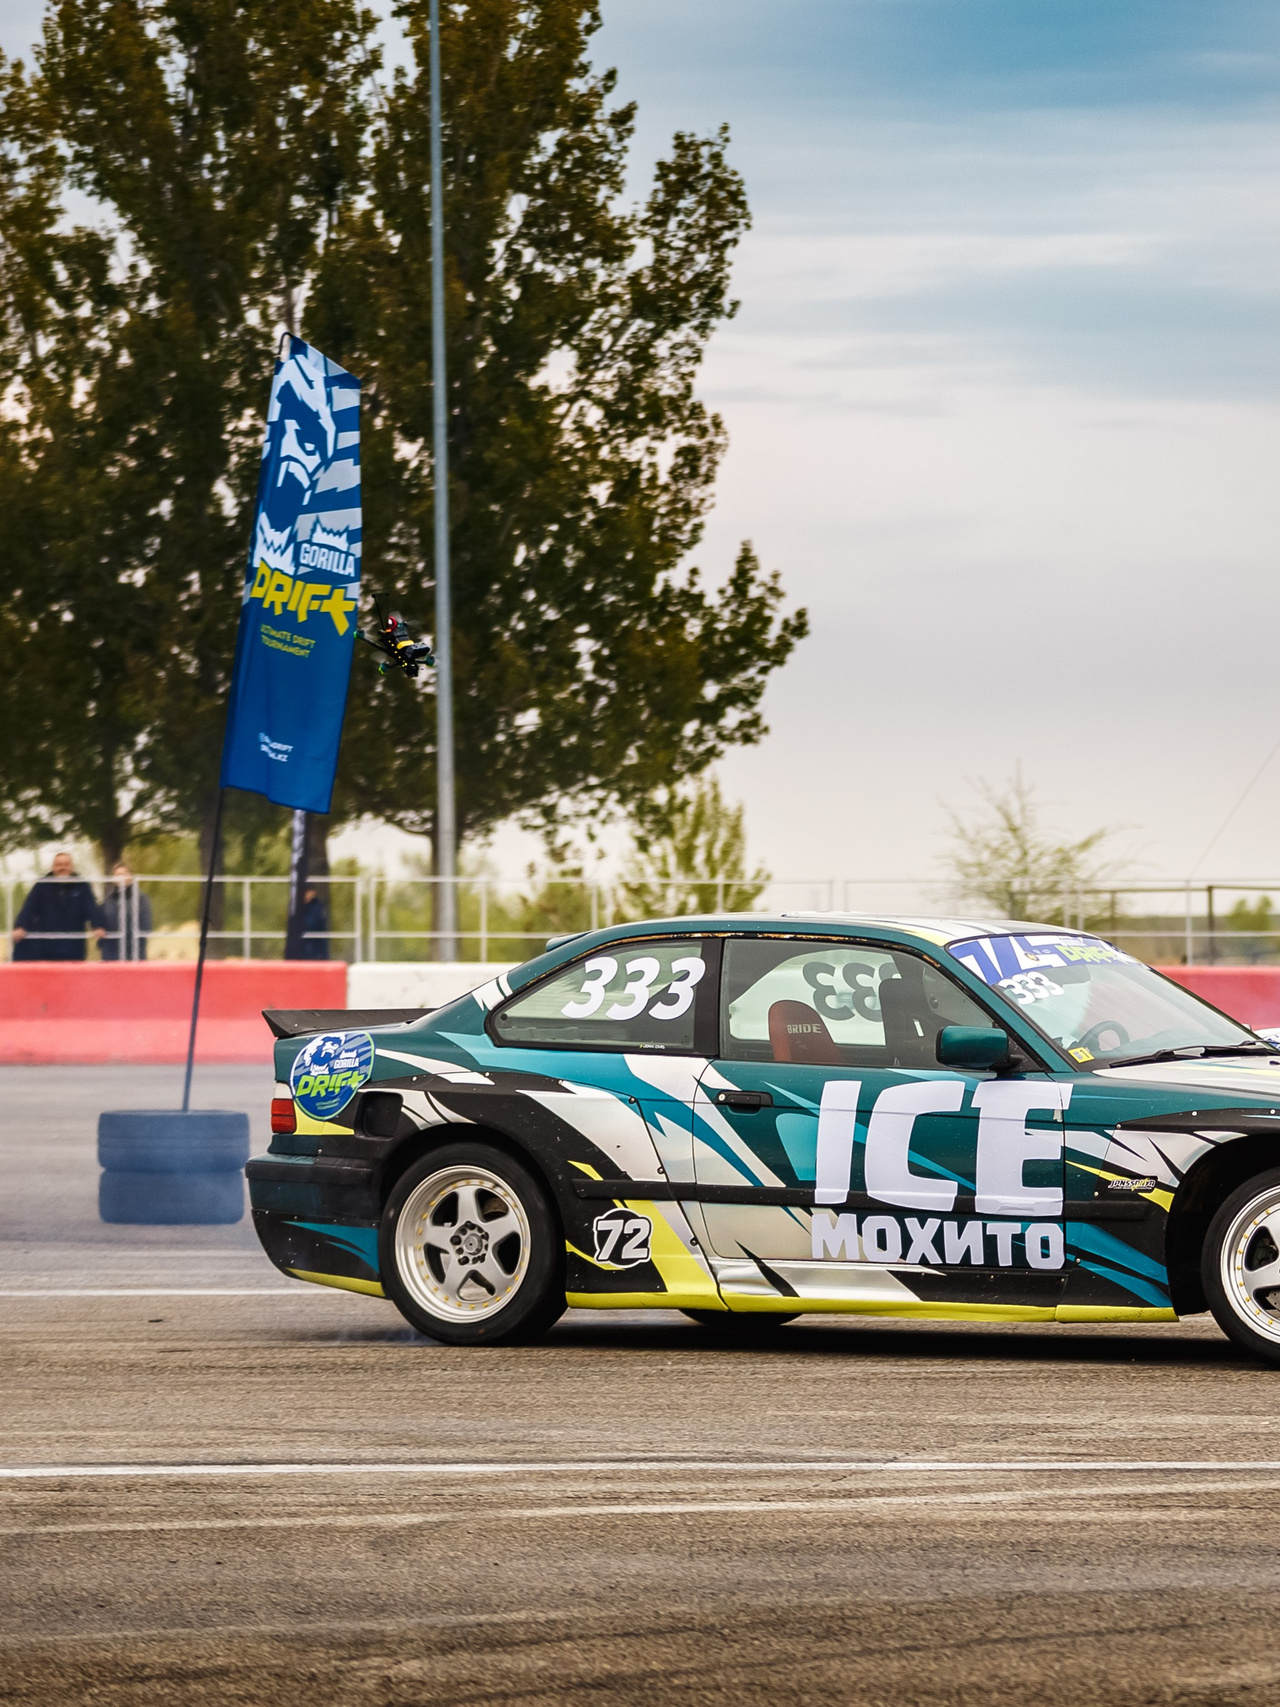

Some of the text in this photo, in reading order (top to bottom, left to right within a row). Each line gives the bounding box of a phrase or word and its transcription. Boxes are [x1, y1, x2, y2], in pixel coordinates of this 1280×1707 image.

[300, 542, 356, 578] GORILLA
[250, 559, 356, 636] DRIFT
[561, 956, 706, 1021] 333
[998, 971, 1064, 1006] 333
[787, 1023, 822, 1034] BRIDE
[295, 1071, 365, 1097] DRIFT
[815, 1080, 1074, 1216] ICE
[597, 1218, 650, 1260] 72
[811, 1212, 1065, 1270] МОХИТО
